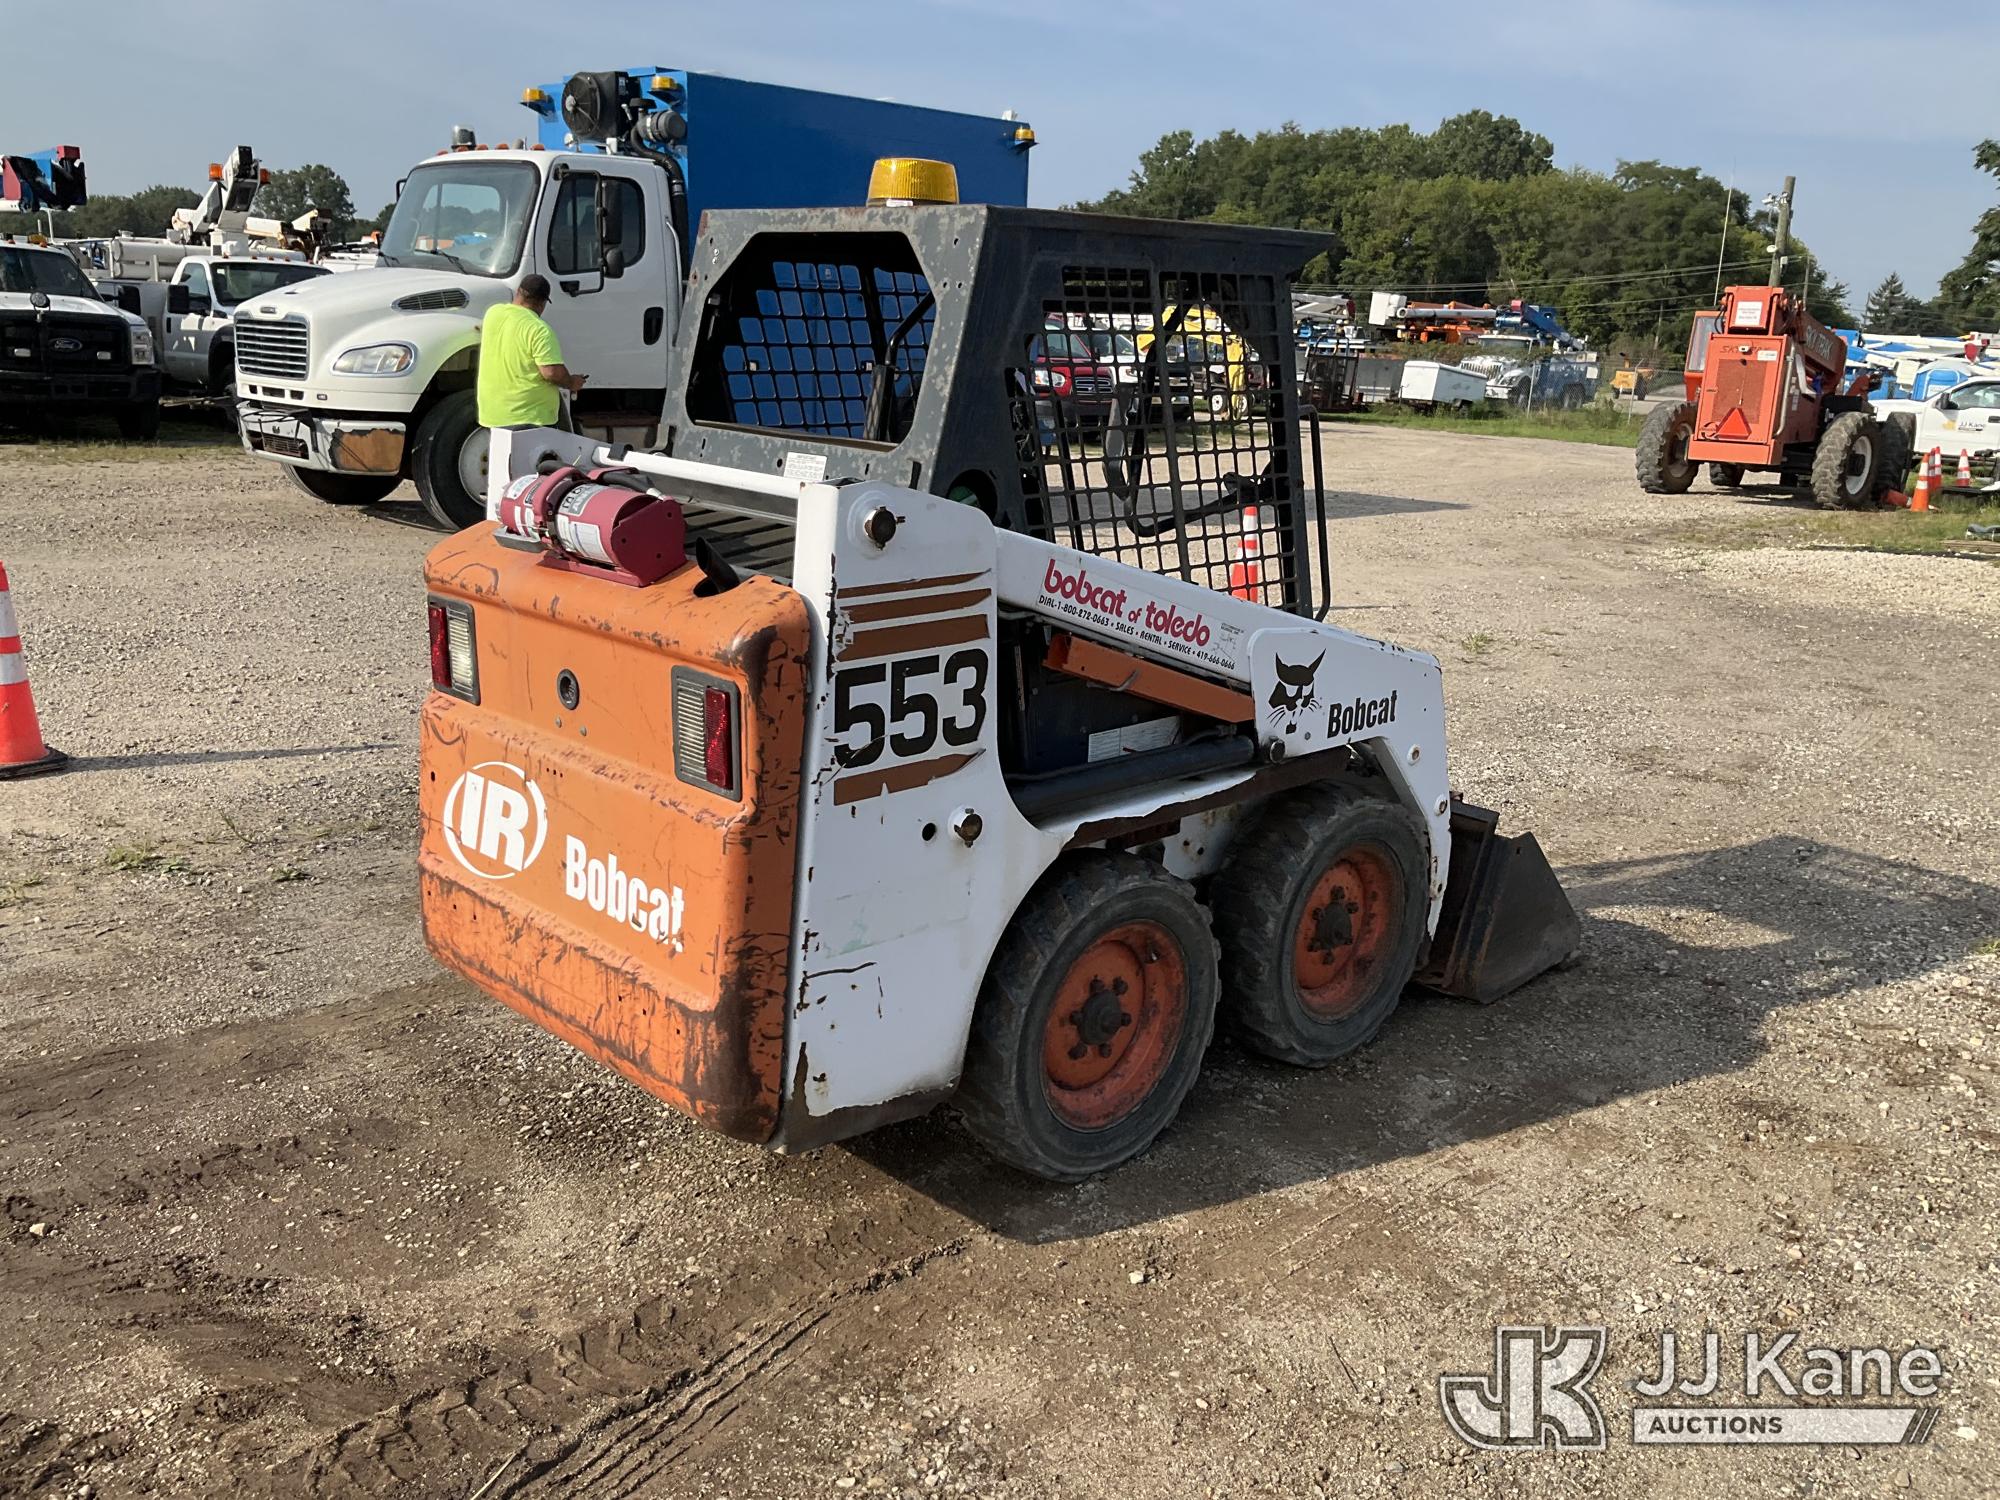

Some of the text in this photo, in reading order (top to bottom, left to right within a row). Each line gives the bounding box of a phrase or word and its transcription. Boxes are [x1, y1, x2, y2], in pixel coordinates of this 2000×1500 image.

[1044, 558, 1211, 647] bobcat of toledo
[1115, 621, 1135, 636] SALES
[1140, 630, 1162, 646] RENTAL
[1168, 640, 1192, 656] SERVICE
[834, 648, 989, 769] 553
[1327, 690, 1398, 739] Bobcat
[459, 770, 529, 872] IR
[565, 834, 684, 952] Bobcat
